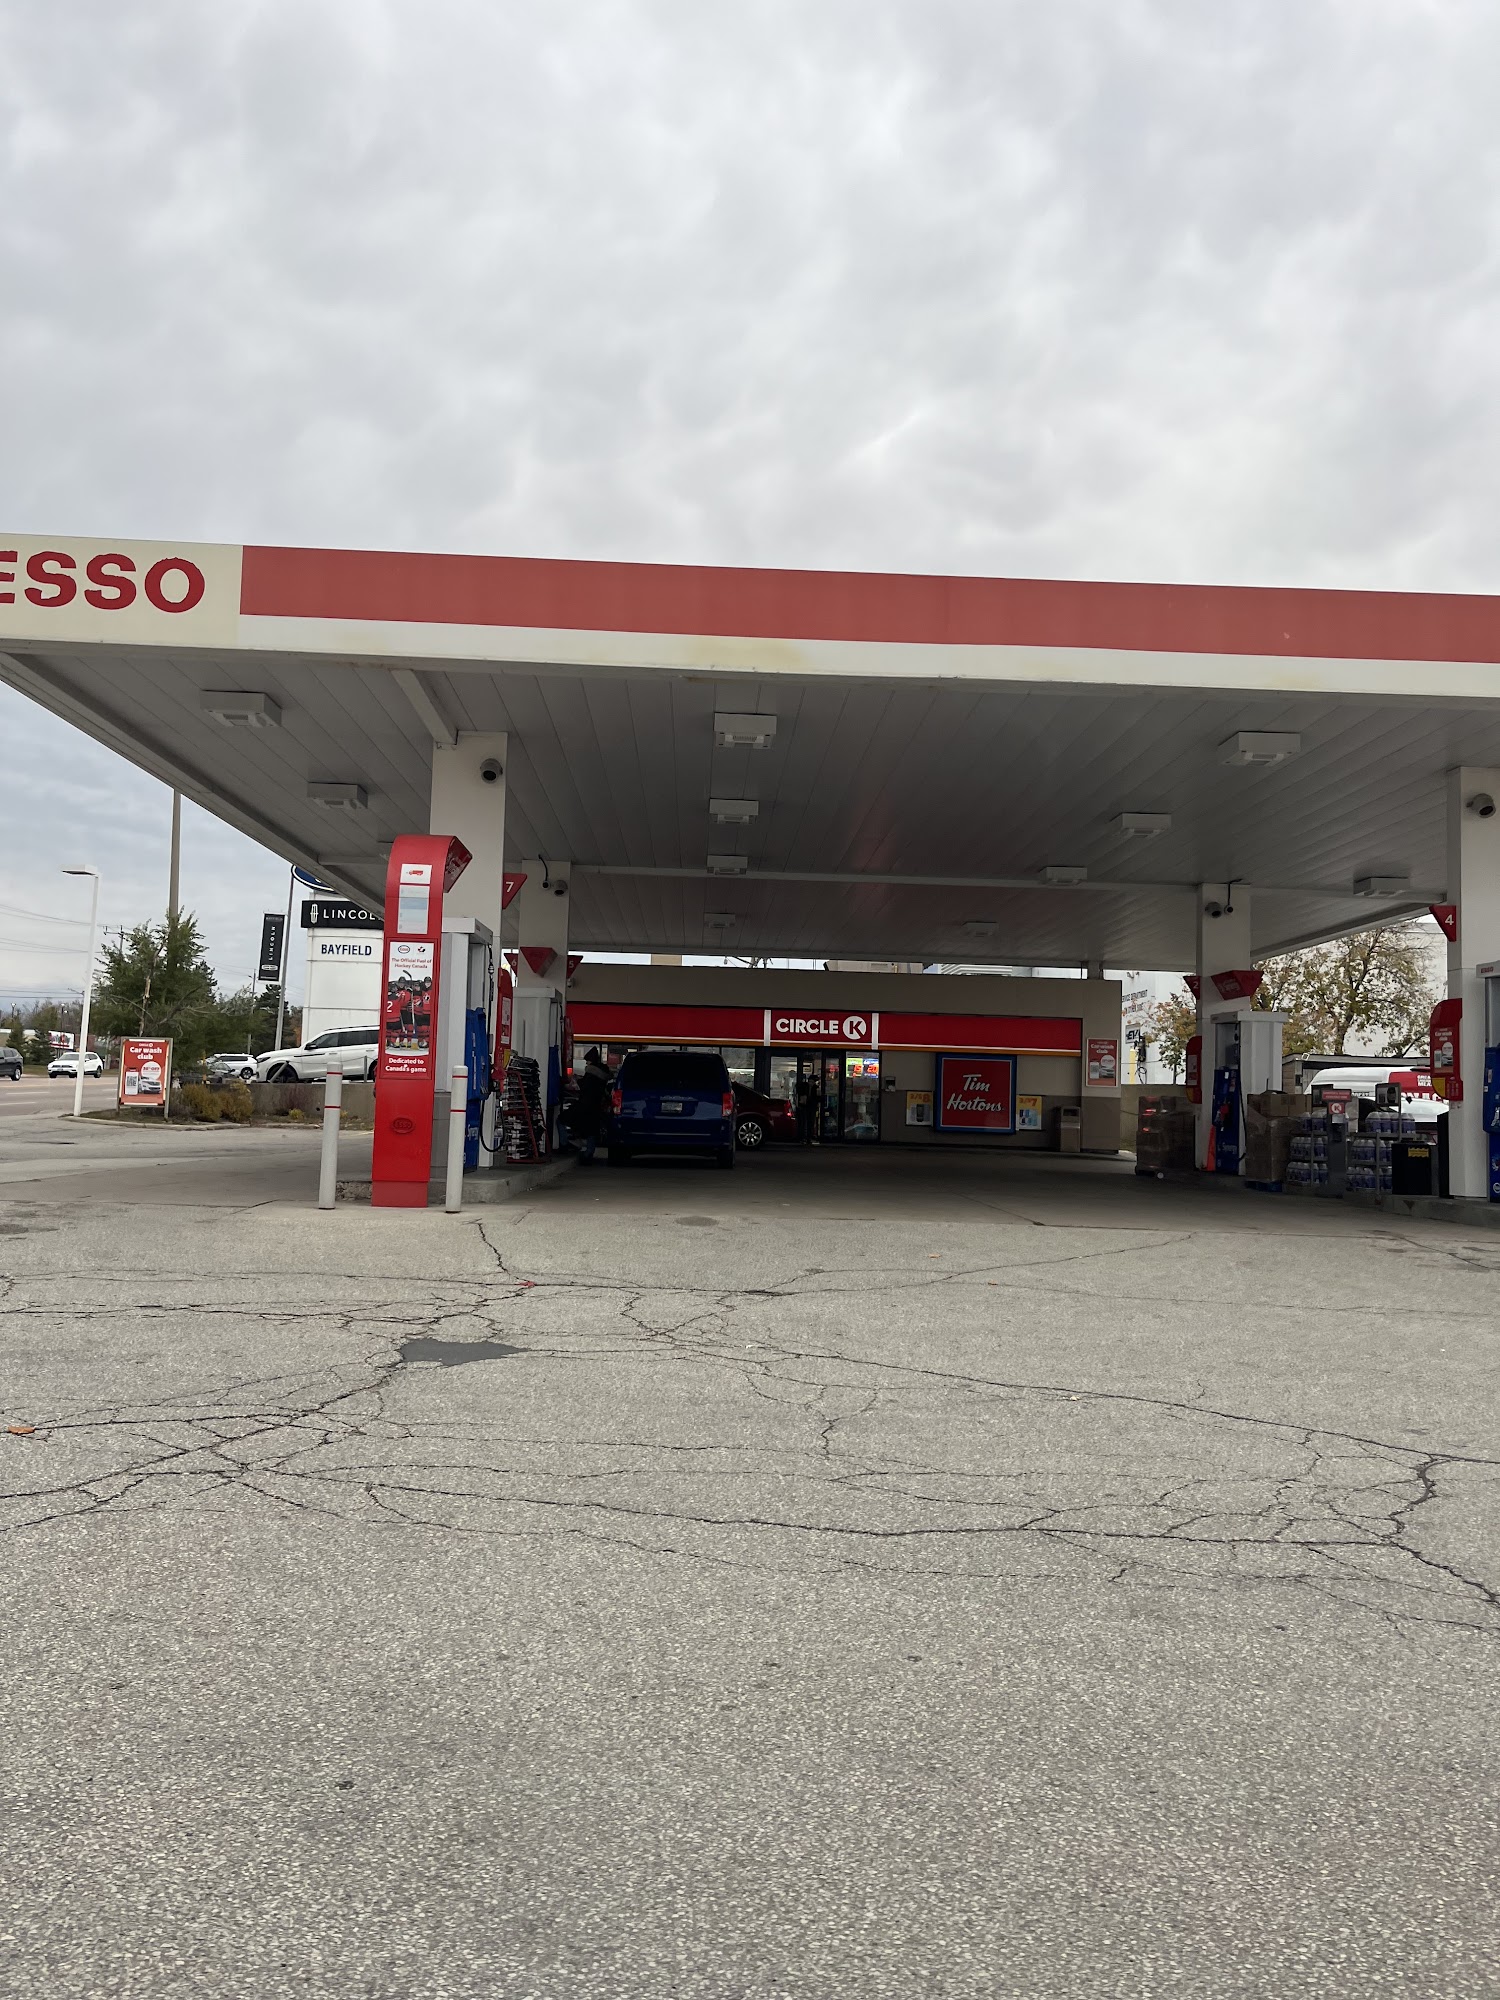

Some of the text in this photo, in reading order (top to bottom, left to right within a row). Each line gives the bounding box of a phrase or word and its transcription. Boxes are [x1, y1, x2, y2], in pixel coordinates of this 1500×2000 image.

[505, 881, 514, 893] 7
[323, 908, 382, 921] LINCOL
[1444, 914, 1455, 926] 4
[321, 943, 373, 956] BAYFIELD
[511, 959, 517, 967] 6
[568, 960, 574, 968] 5
[1192, 980, 1200, 990] 2
[775, 1016, 866, 1039] CIRCLE K
[388, 1057, 417, 1065] Dedicated
[962, 1073, 990, 1092] Tim
[946, 1092, 1002, 1112] Hortons
